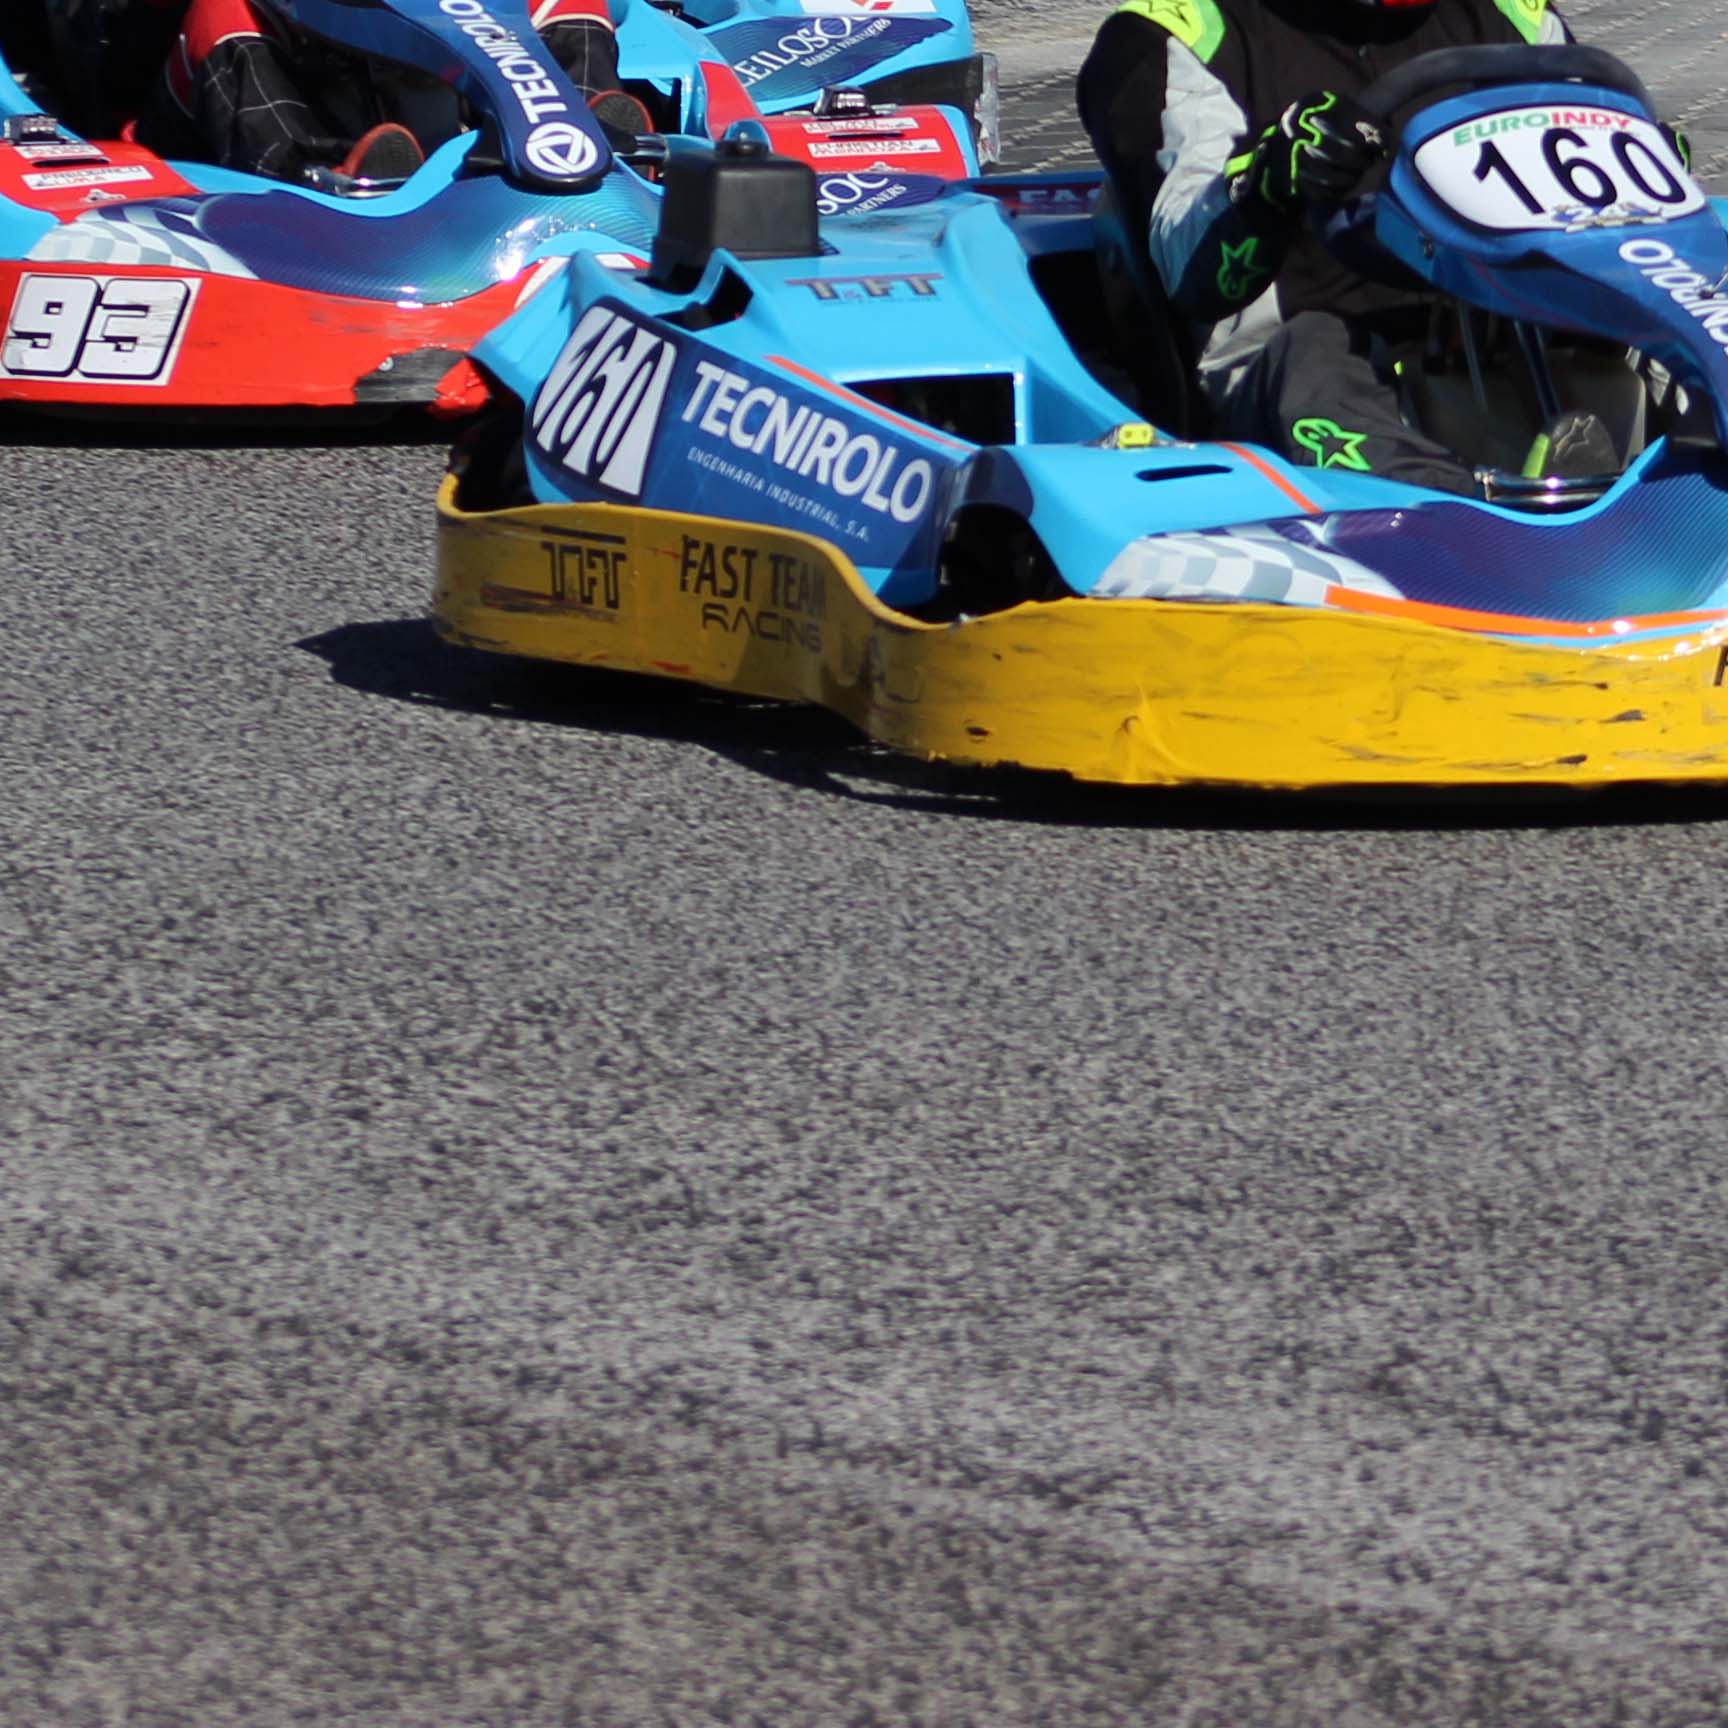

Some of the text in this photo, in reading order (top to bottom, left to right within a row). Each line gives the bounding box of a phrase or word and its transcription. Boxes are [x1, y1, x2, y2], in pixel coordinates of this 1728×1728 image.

[1453, 111, 1630, 147] EUROINDY
[1472, 127, 1687, 215] 160
[0, 274, 191, 381] 93
[681, 359, 932, 524] TECNIROLO
[687, 445, 765, 493] ENGENHARIA
[679, 534, 826, 619] FAST TEAM
[702, 603, 822, 652] RACING
